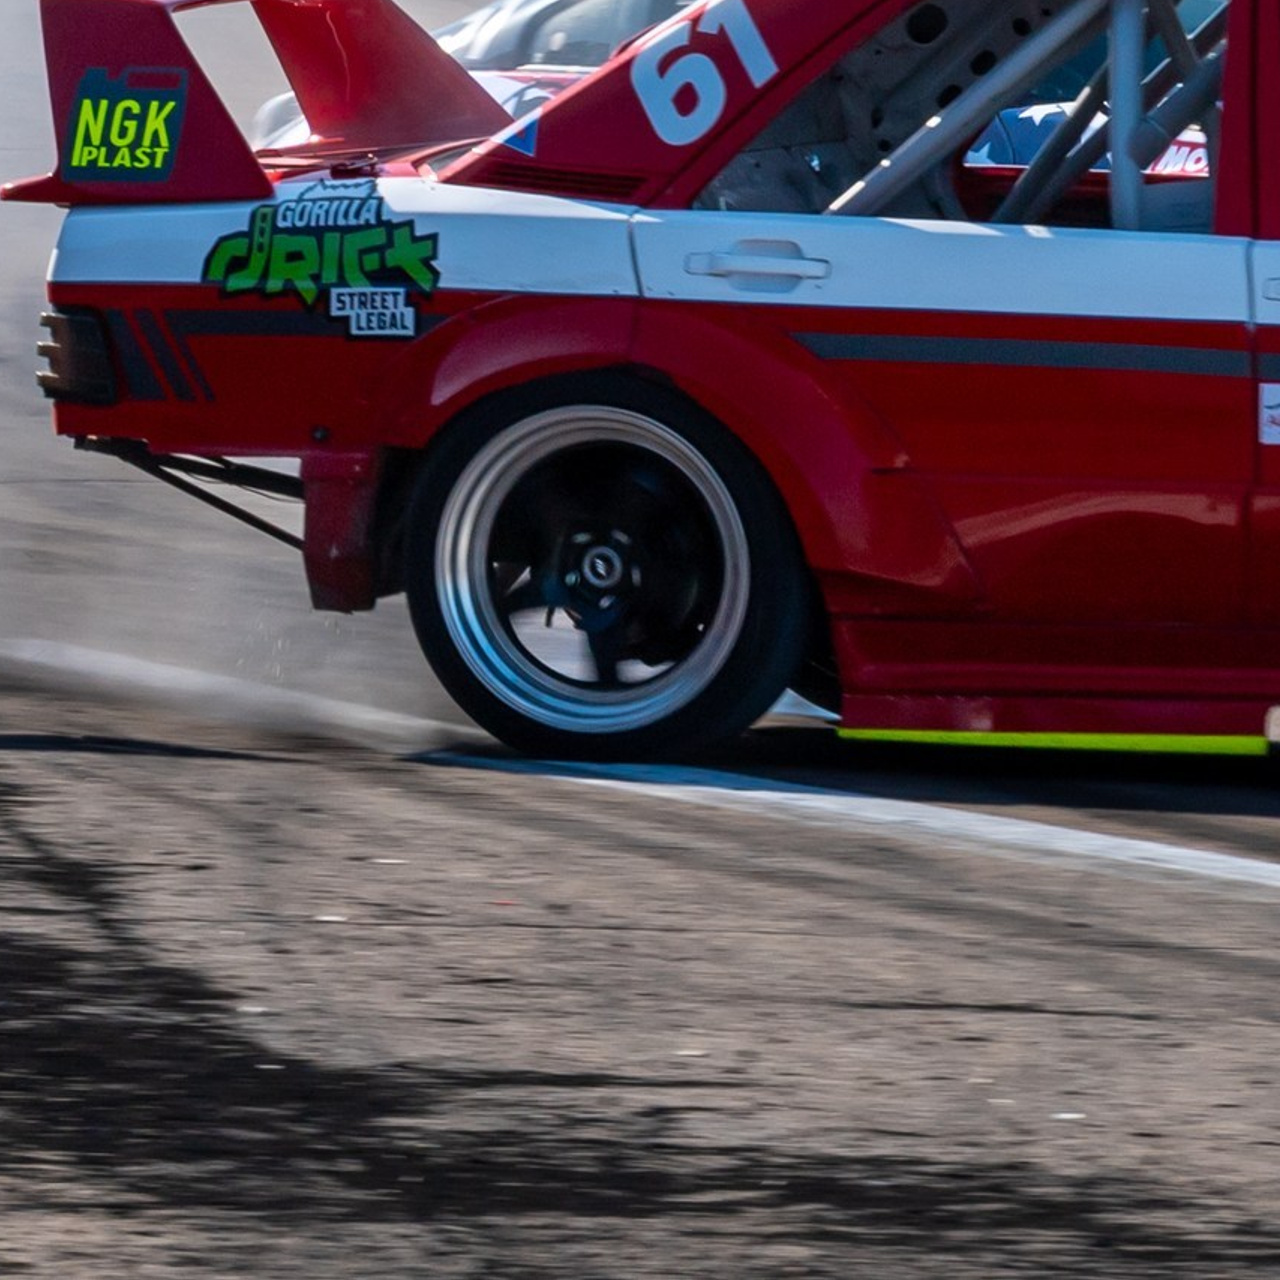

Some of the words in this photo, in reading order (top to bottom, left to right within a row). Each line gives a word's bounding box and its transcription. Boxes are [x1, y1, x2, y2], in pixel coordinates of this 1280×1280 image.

[71, 99, 175, 166] NGK
[81, 146, 169, 168] PLAST
[276, 198, 379, 228] GORILLA
[336, 290, 402, 311] STREET
[355, 312, 410, 331] LEGAL
